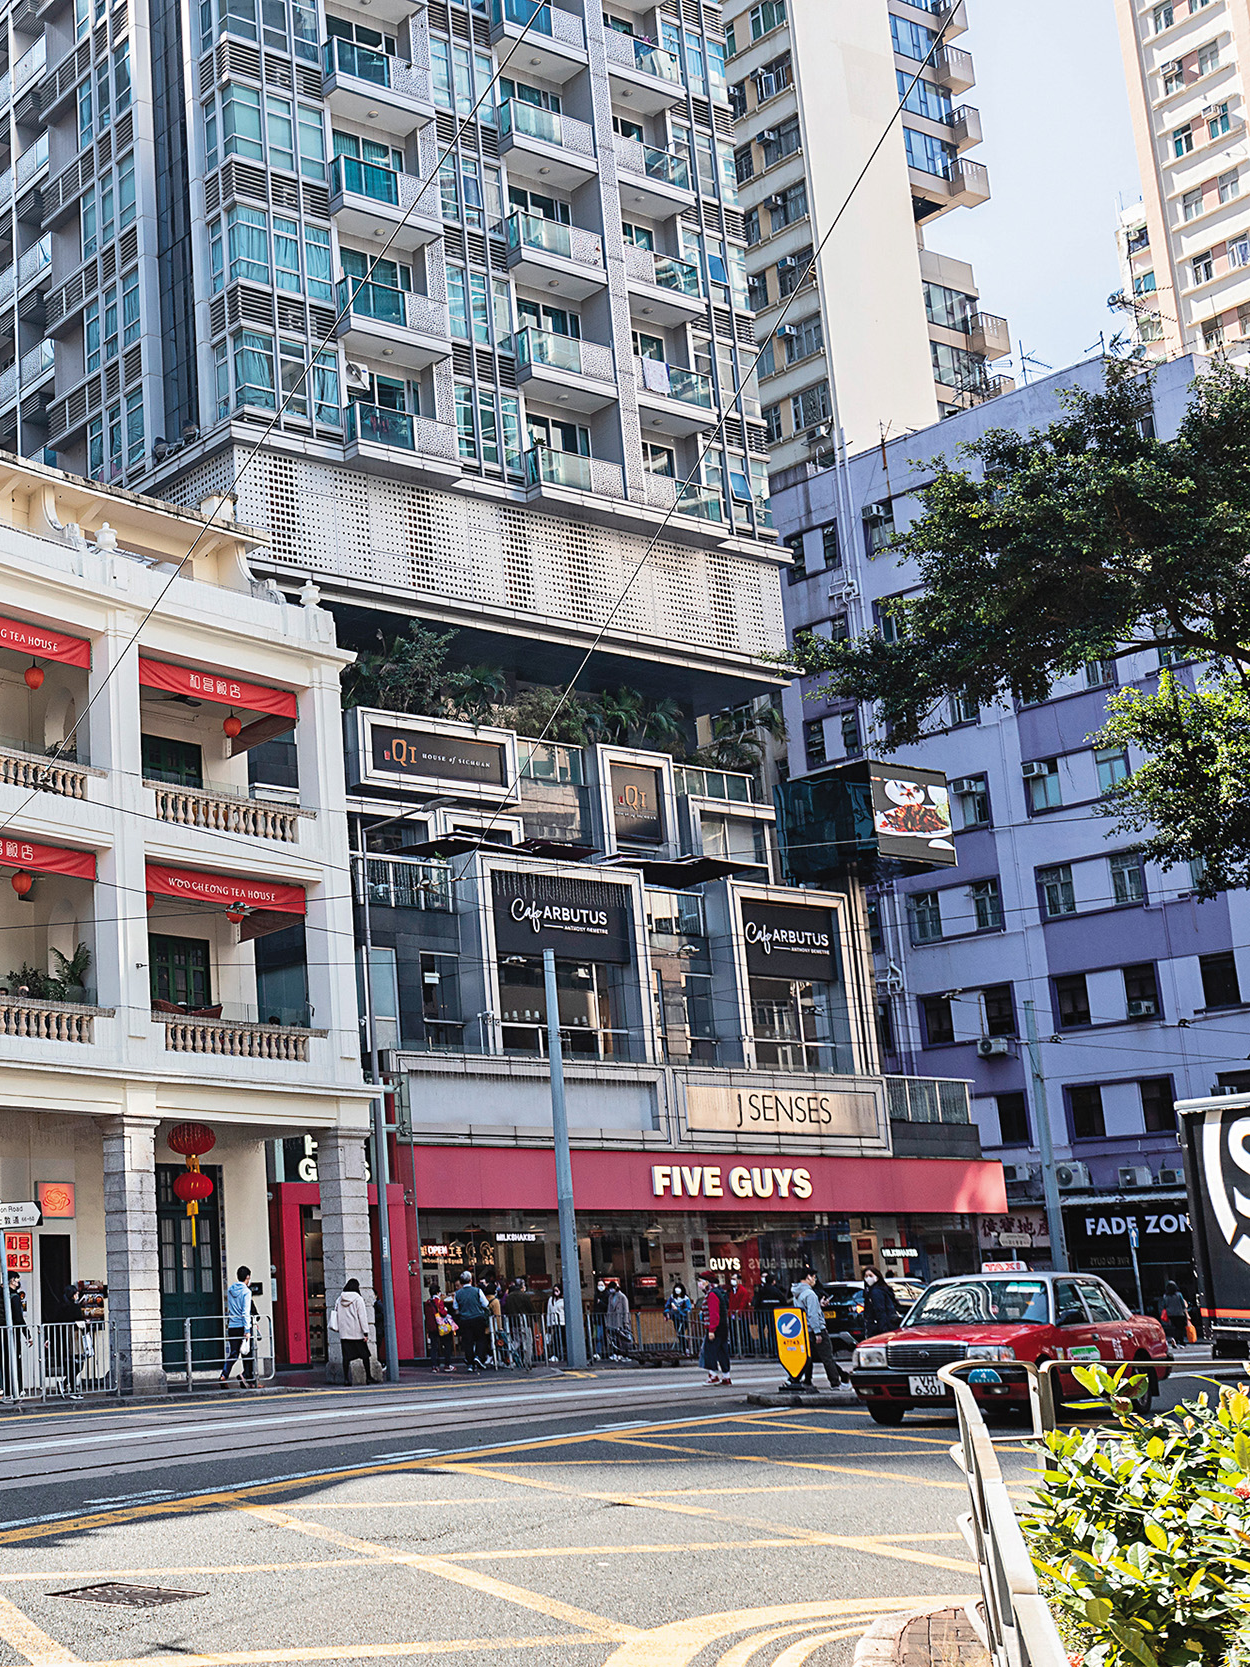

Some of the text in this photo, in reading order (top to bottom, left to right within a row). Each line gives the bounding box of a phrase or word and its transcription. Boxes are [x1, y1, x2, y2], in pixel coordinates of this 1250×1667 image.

[9, 631, 27, 644] TEA
[28, 636, 59, 652] HOUSE
[391, 738, 491, 769] QI HOUSE of SICHUAN
[625, 785, 647, 811] QI
[168, 877, 276, 902] WOO CHEONG TEA HOUSE
[543, 906, 608, 926] ARBUTUS
[772, 928, 829, 947] ARBUTUS
[736, 1093, 832, 1128] J SENSES
[651, 1165, 813, 1199] FIVE GUYS
[8, 1205, 23, 1213] Road
[1085, 1216, 1137, 1235] FADE
[427, 1245, 448, 1255] OPEN
[710, 1257, 741, 1270] GUYS
[985, 1262, 1021, 1271] TAXI
[915, 1385, 942, 1395] 6301
[919, 1375, 934, 1386] VH
